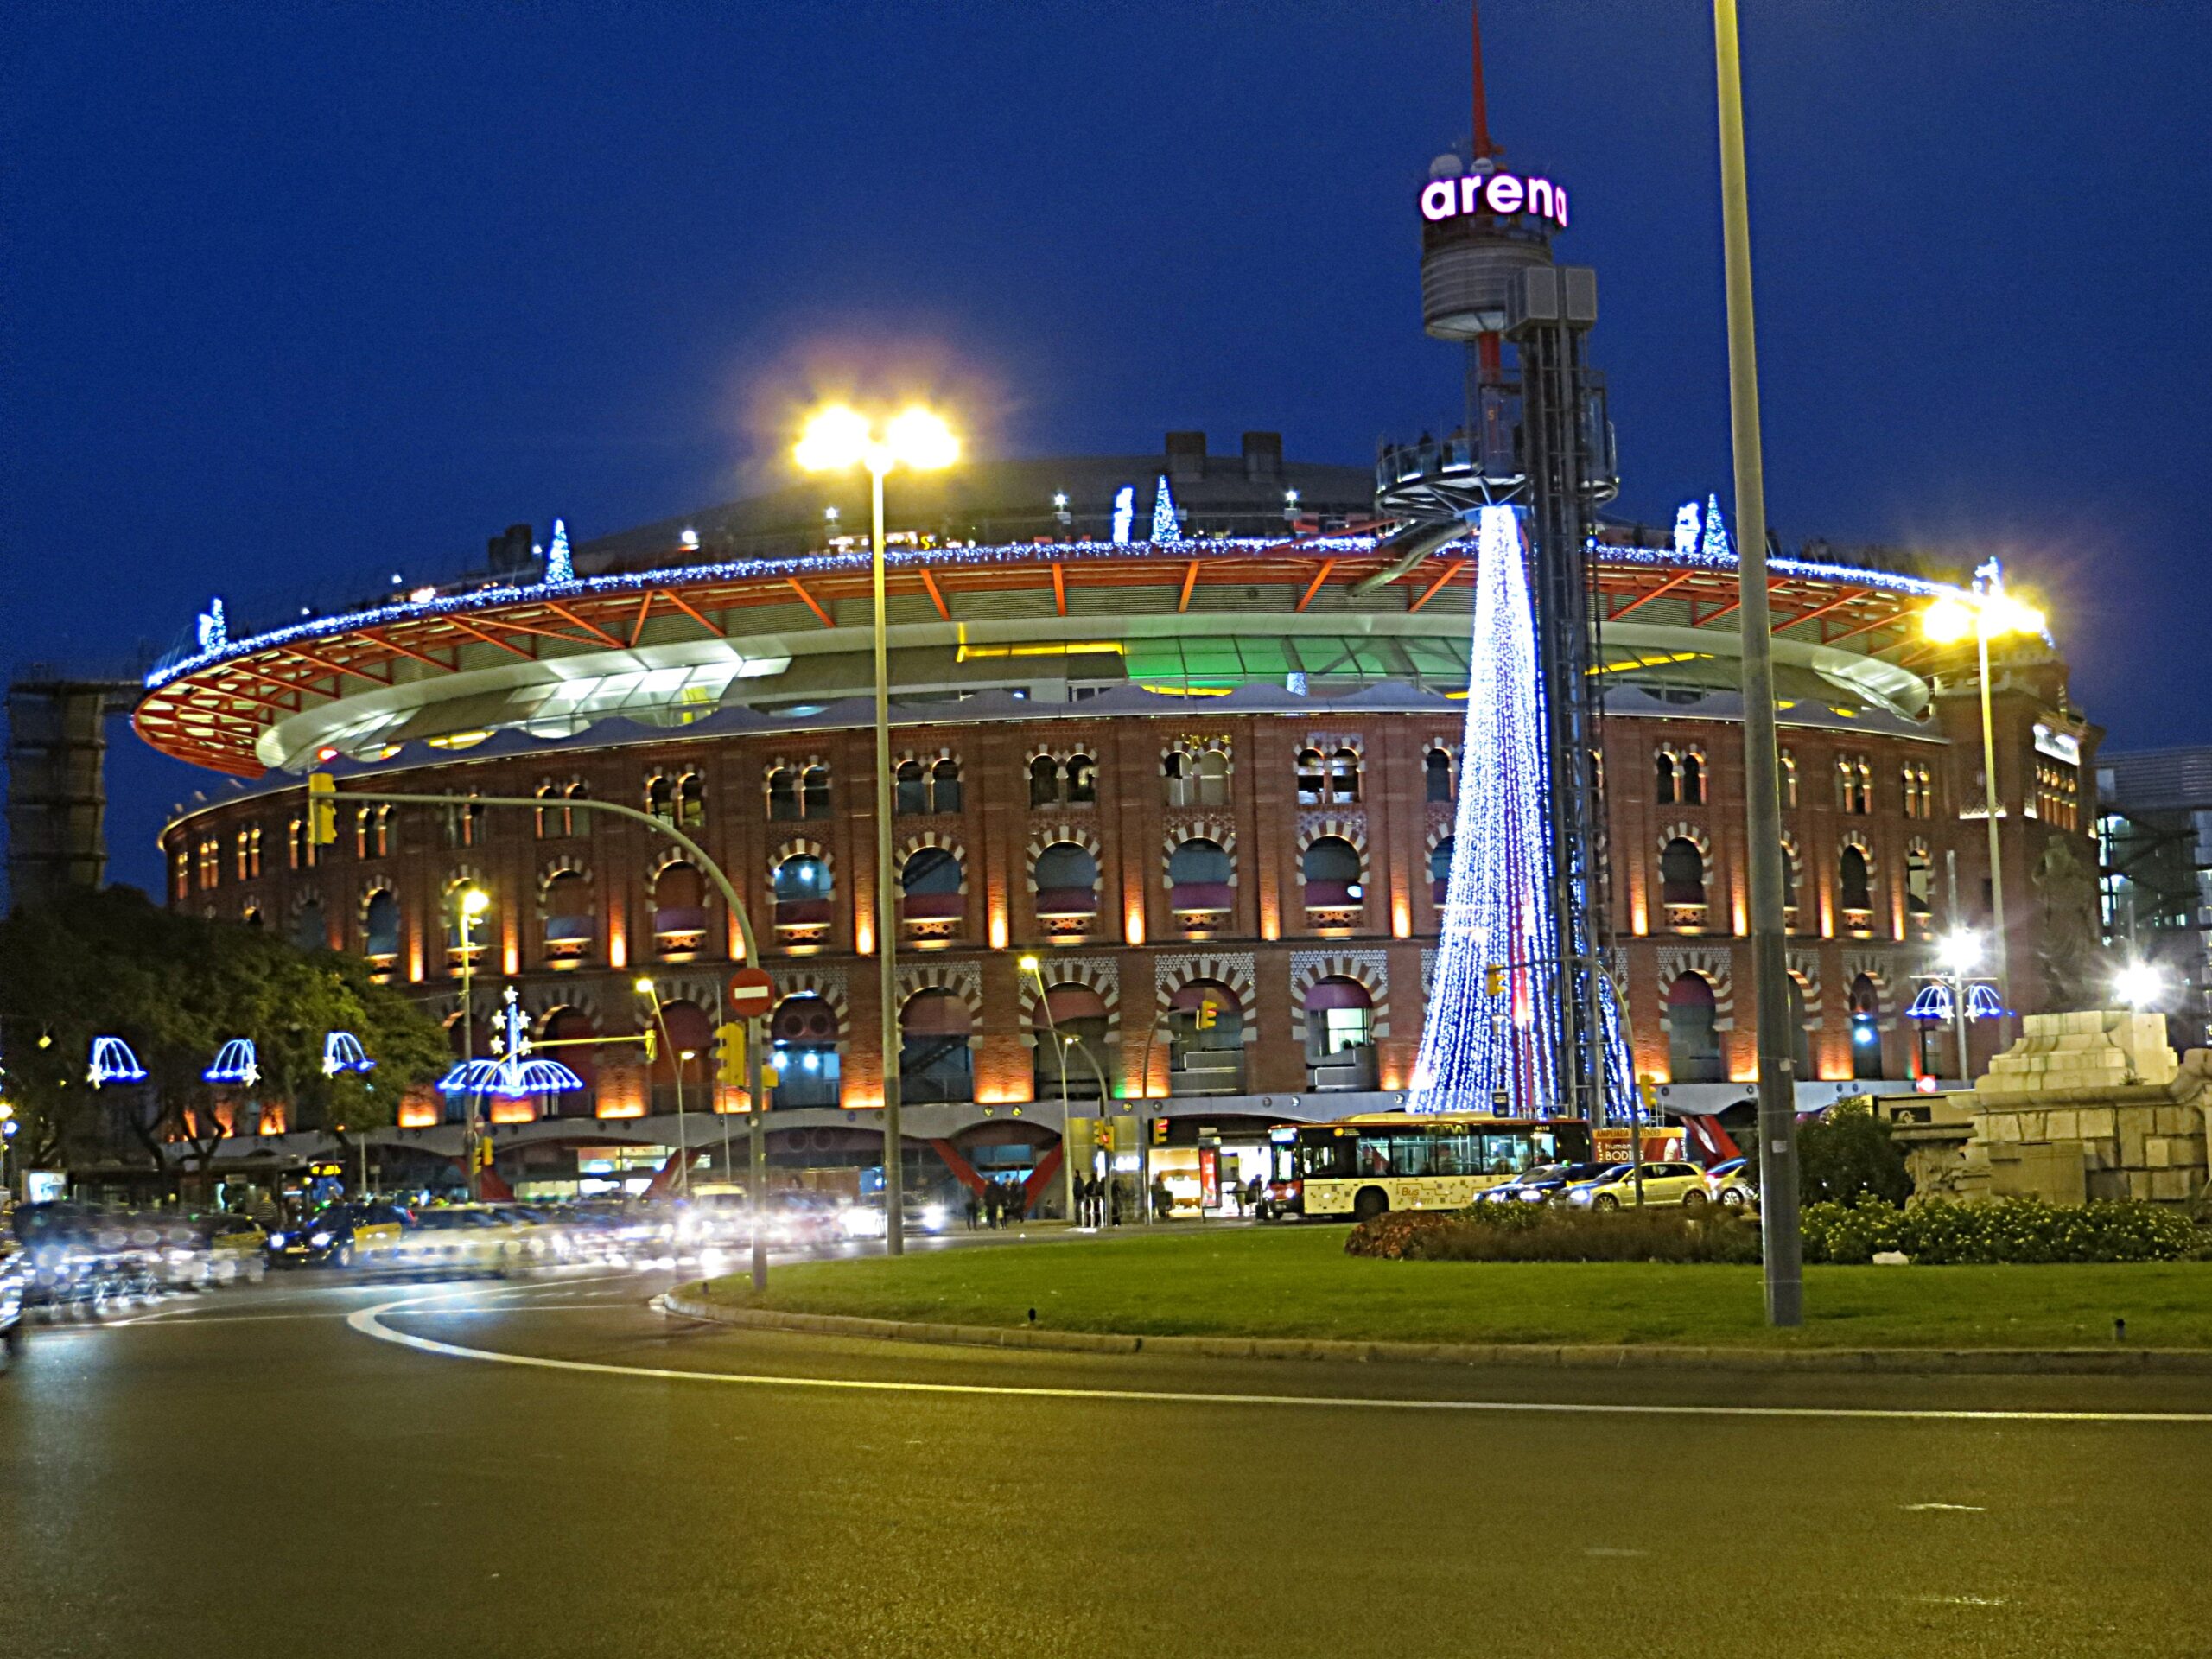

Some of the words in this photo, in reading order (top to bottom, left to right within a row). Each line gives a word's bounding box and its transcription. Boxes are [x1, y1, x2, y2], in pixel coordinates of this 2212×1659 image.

[1421, 174, 1568, 227] arena
[1605, 1150, 1644, 1161] BODIS
[1402, 1187, 1420, 1197] Bus
